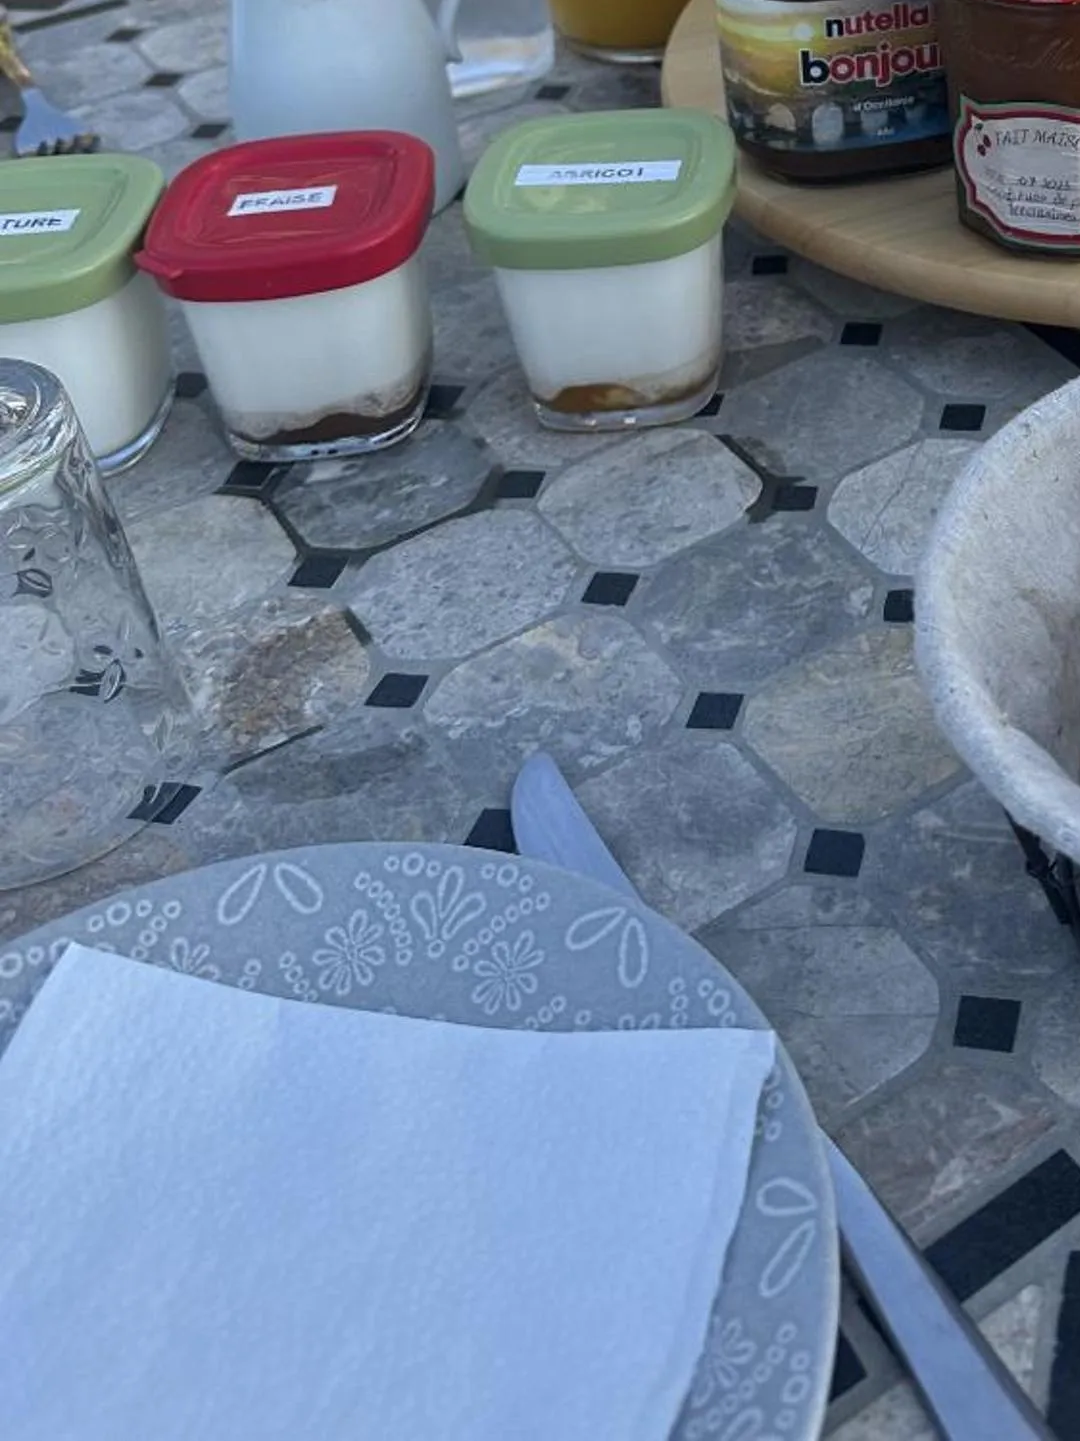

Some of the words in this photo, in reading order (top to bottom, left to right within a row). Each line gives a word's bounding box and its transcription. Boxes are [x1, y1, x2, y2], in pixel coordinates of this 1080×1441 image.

[825, 3, 930, 38] nutella
[800, 41, 943, 87] bonjou
[239, 191, 324, 210] FRAISE
